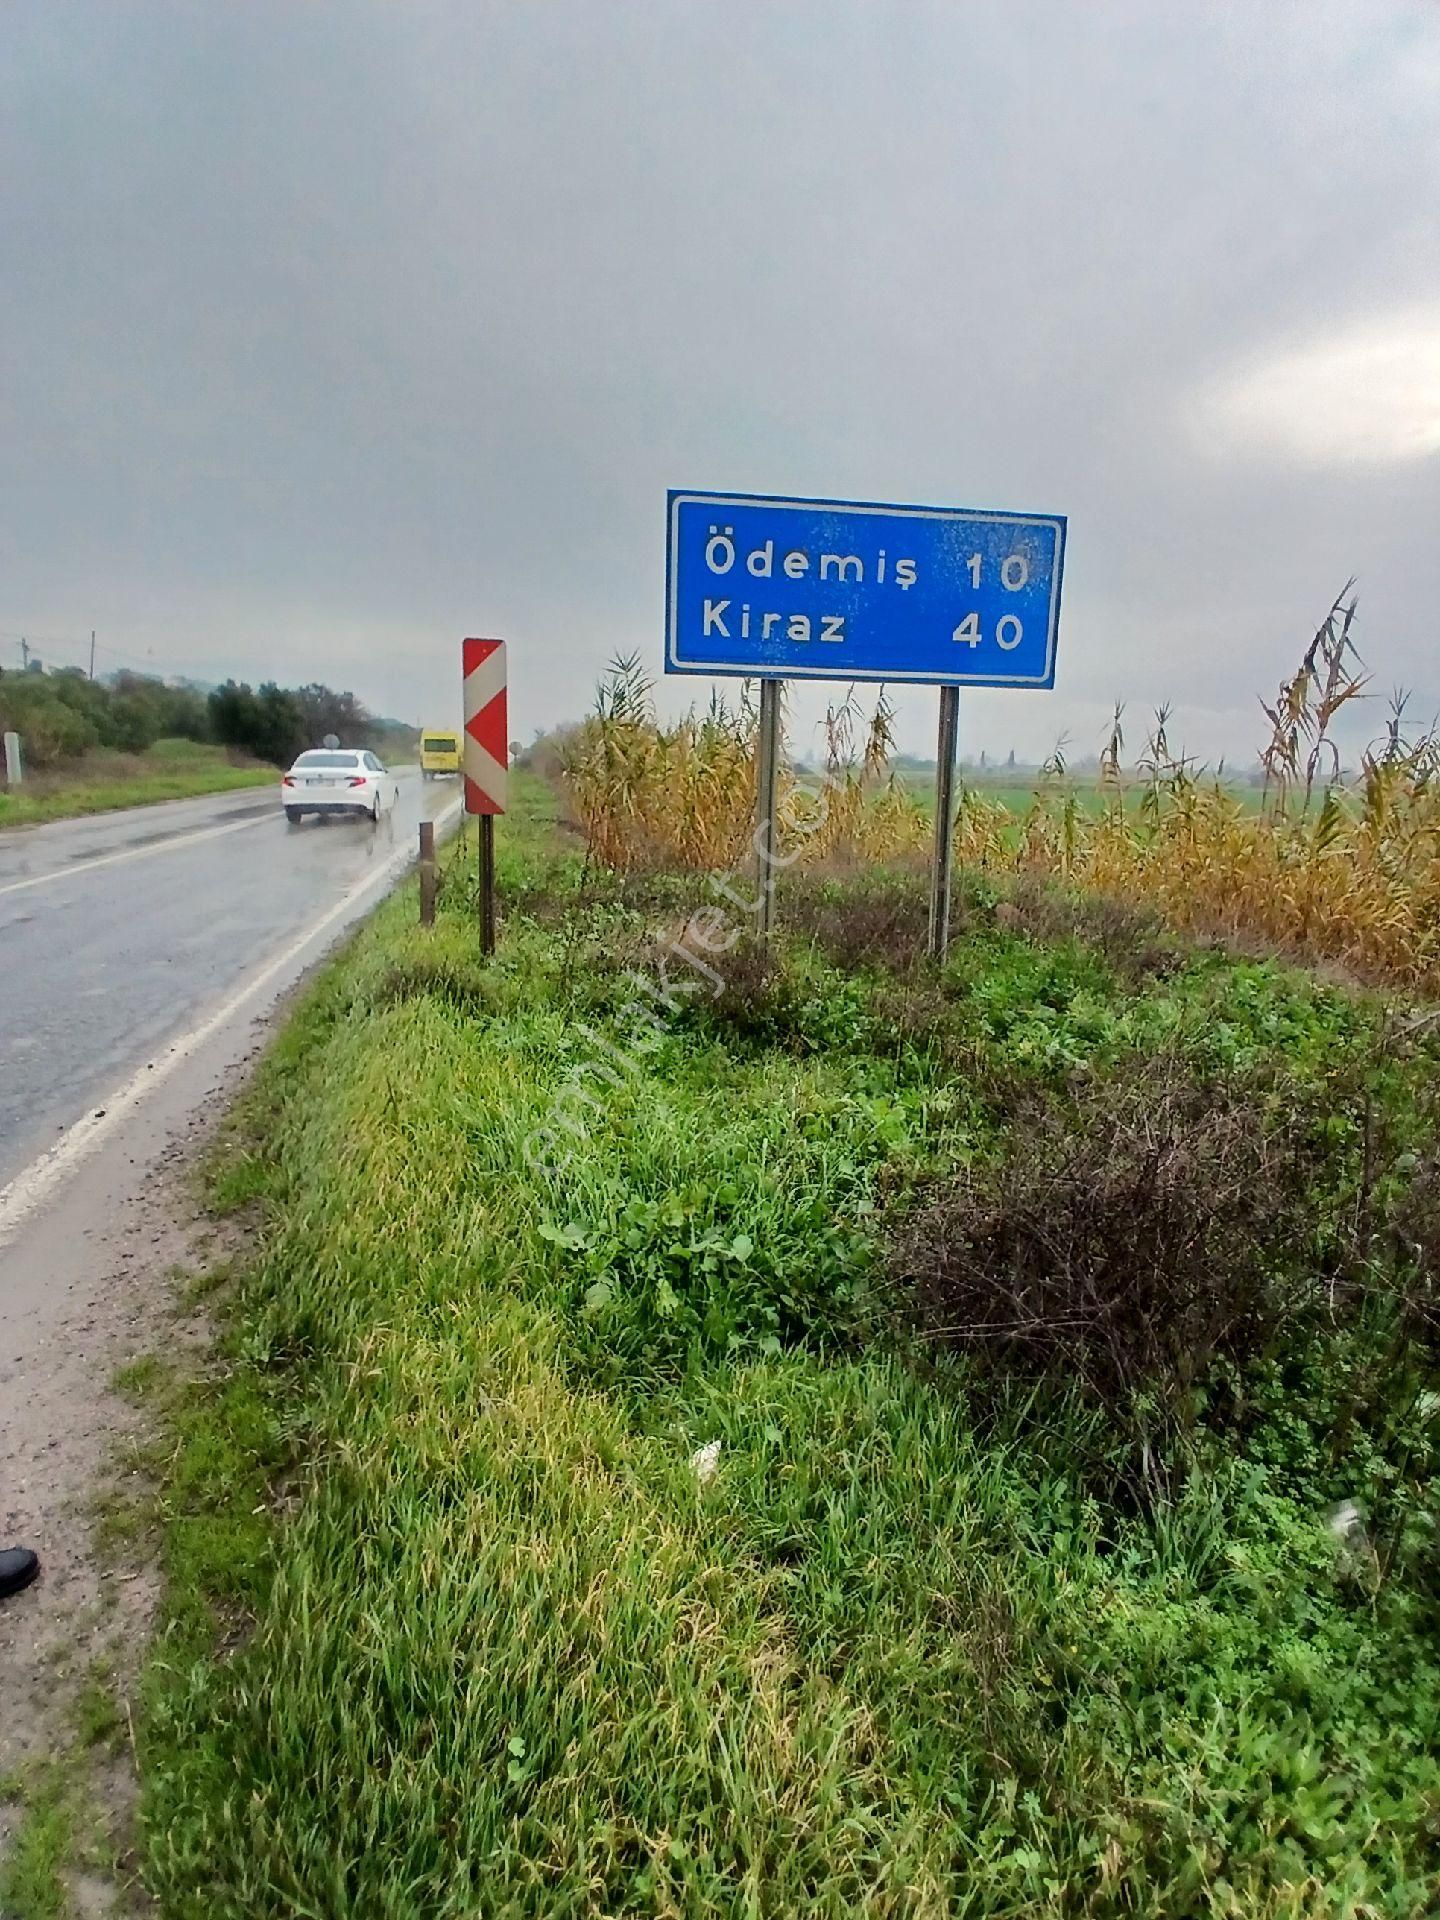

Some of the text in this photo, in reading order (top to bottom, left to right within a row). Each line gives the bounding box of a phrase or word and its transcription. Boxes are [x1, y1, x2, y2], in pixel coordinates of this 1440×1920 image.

[704, 525, 1029, 592] Ödemiş 10
[703, 599, 1024, 651] Kiraz 40
